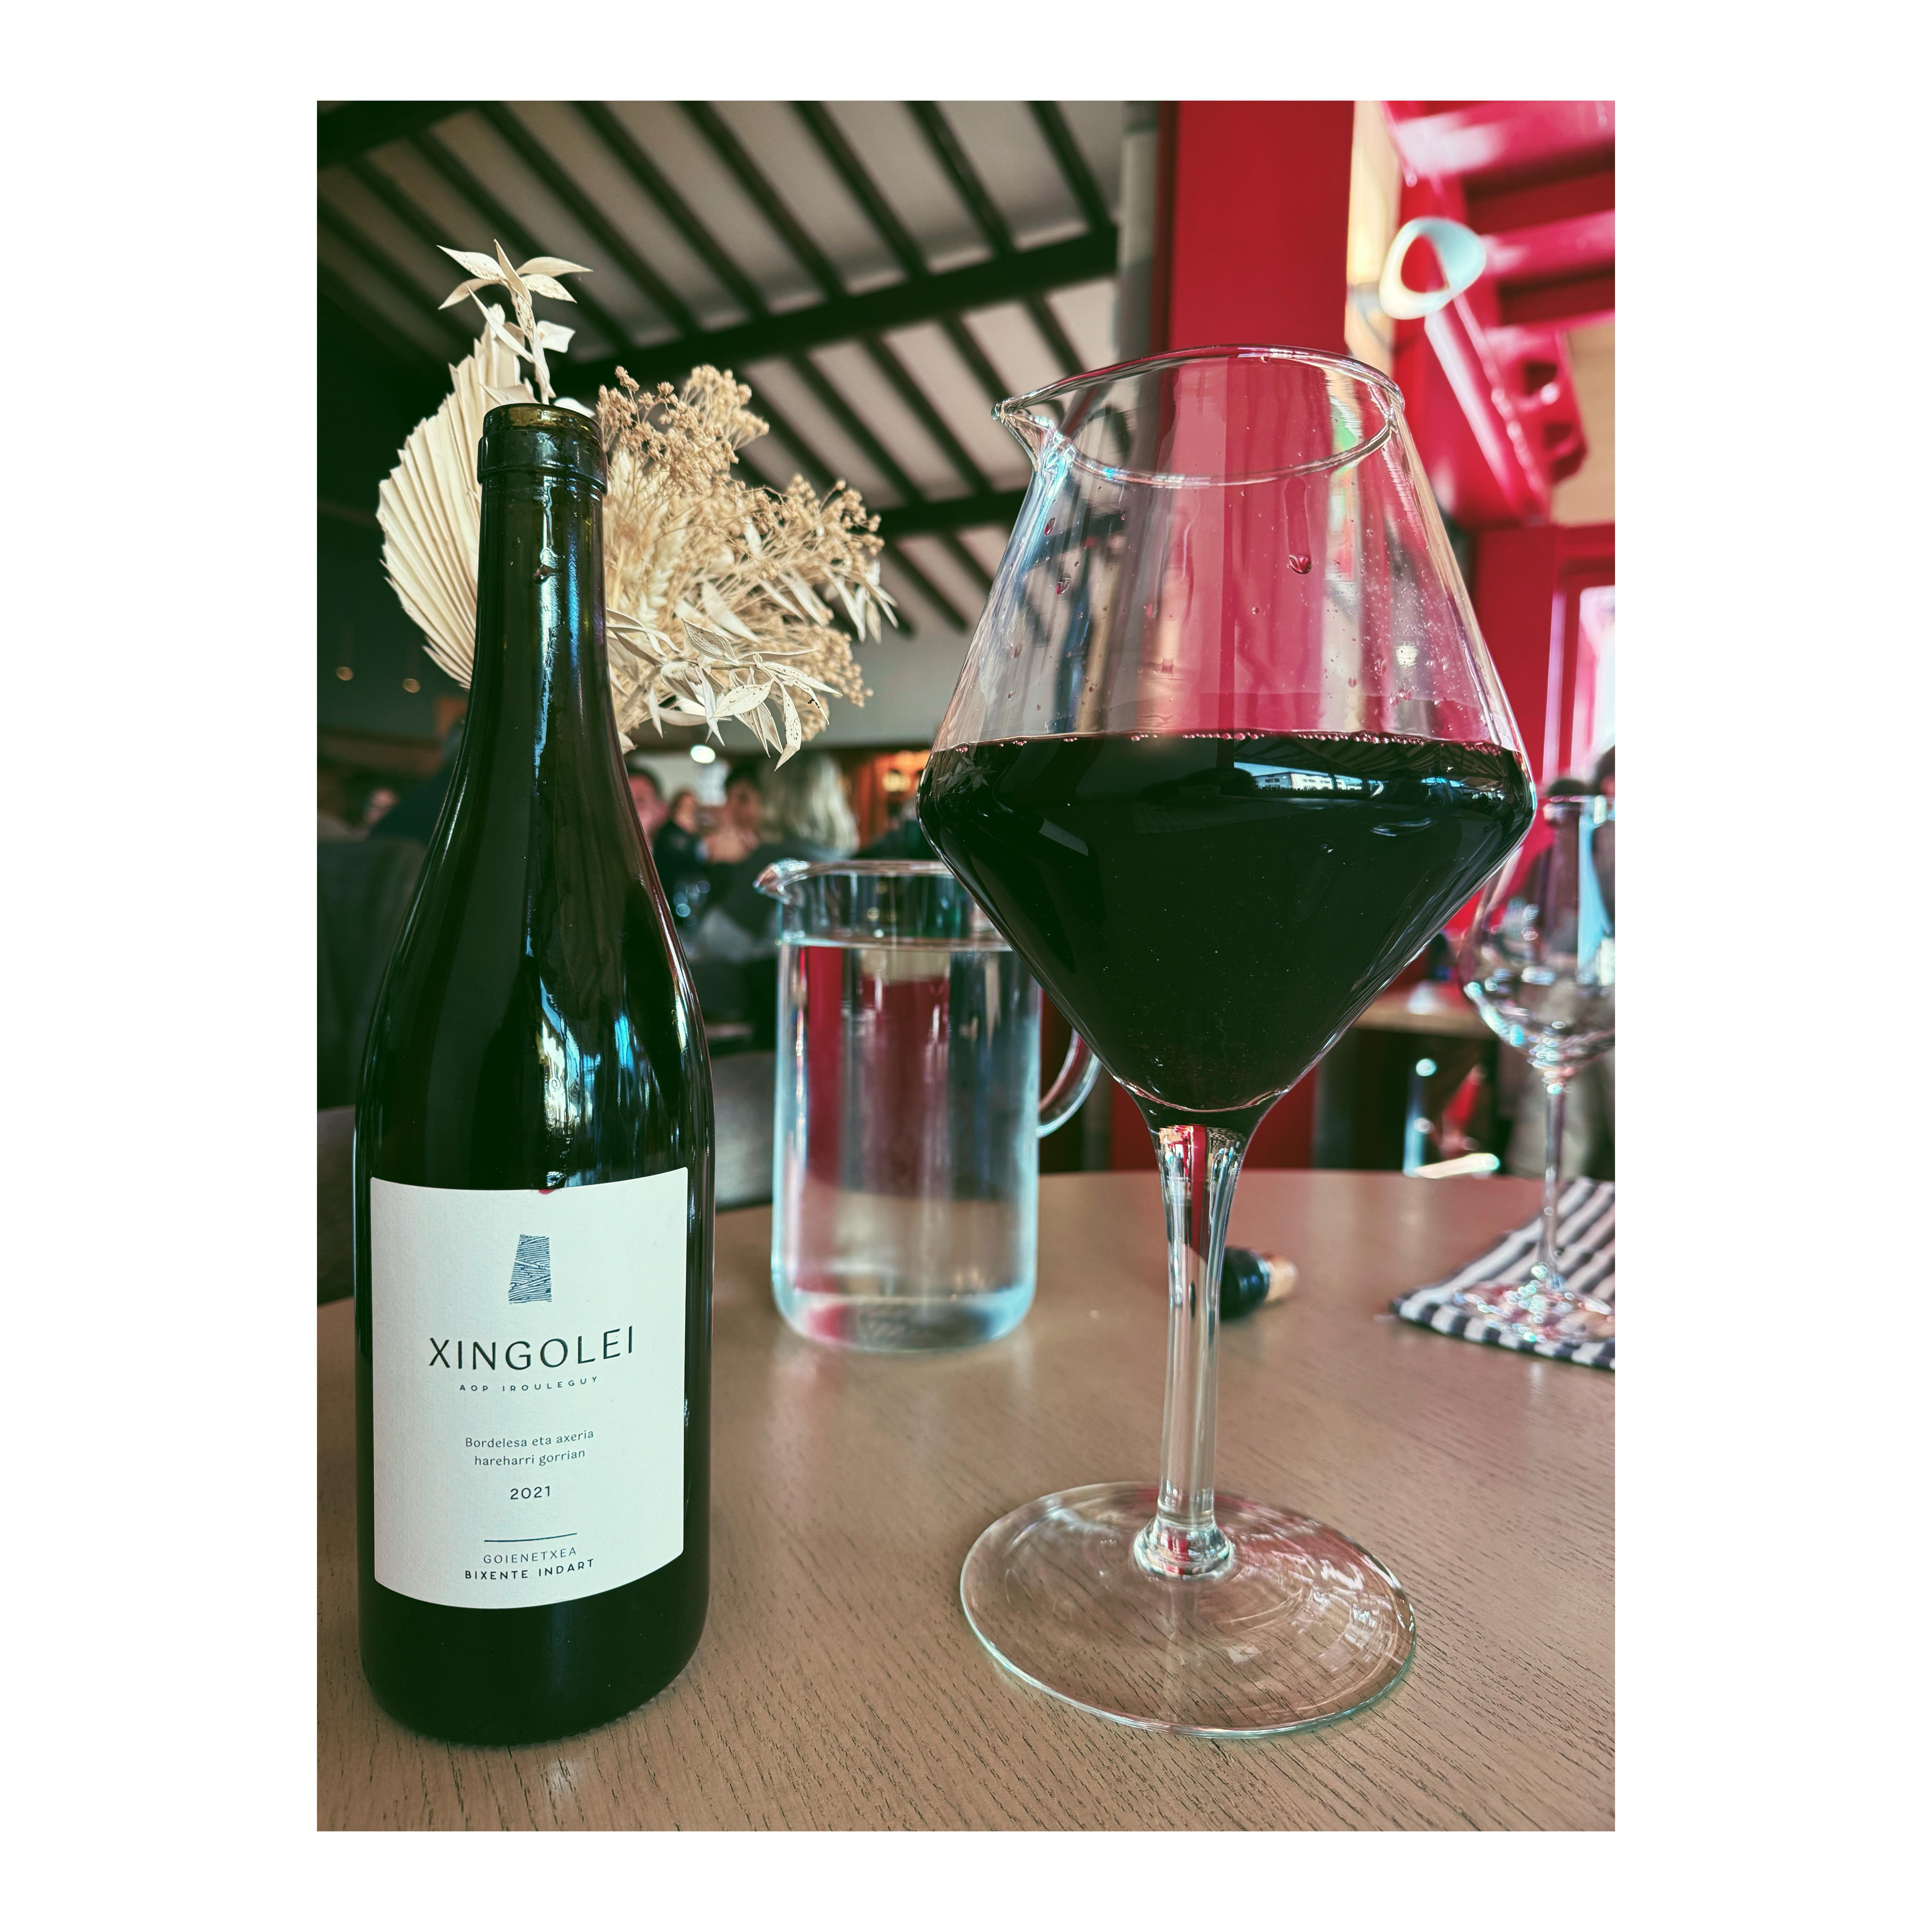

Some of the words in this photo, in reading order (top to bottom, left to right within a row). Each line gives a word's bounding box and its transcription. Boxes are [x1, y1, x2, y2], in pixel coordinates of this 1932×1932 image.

[429, 1325, 633, 1371] XINGOLEI
[502, 1376, 597, 1392] IROULEGUY
[465, 1437, 528, 1448] Bordelesa
[532, 1437, 552, 1446] eta
[556, 1430, 594, 1443] axeria
[474, 1454, 534, 1466] hareharri
[539, 1450, 585, 1466] gorrian
[510, 1485, 551, 1500] 2021
[483, 1546, 577, 1564] GOIENETXEA
[465, 1569, 529, 1580] BIXENTE
[538, 1558, 594, 1577] INDART
